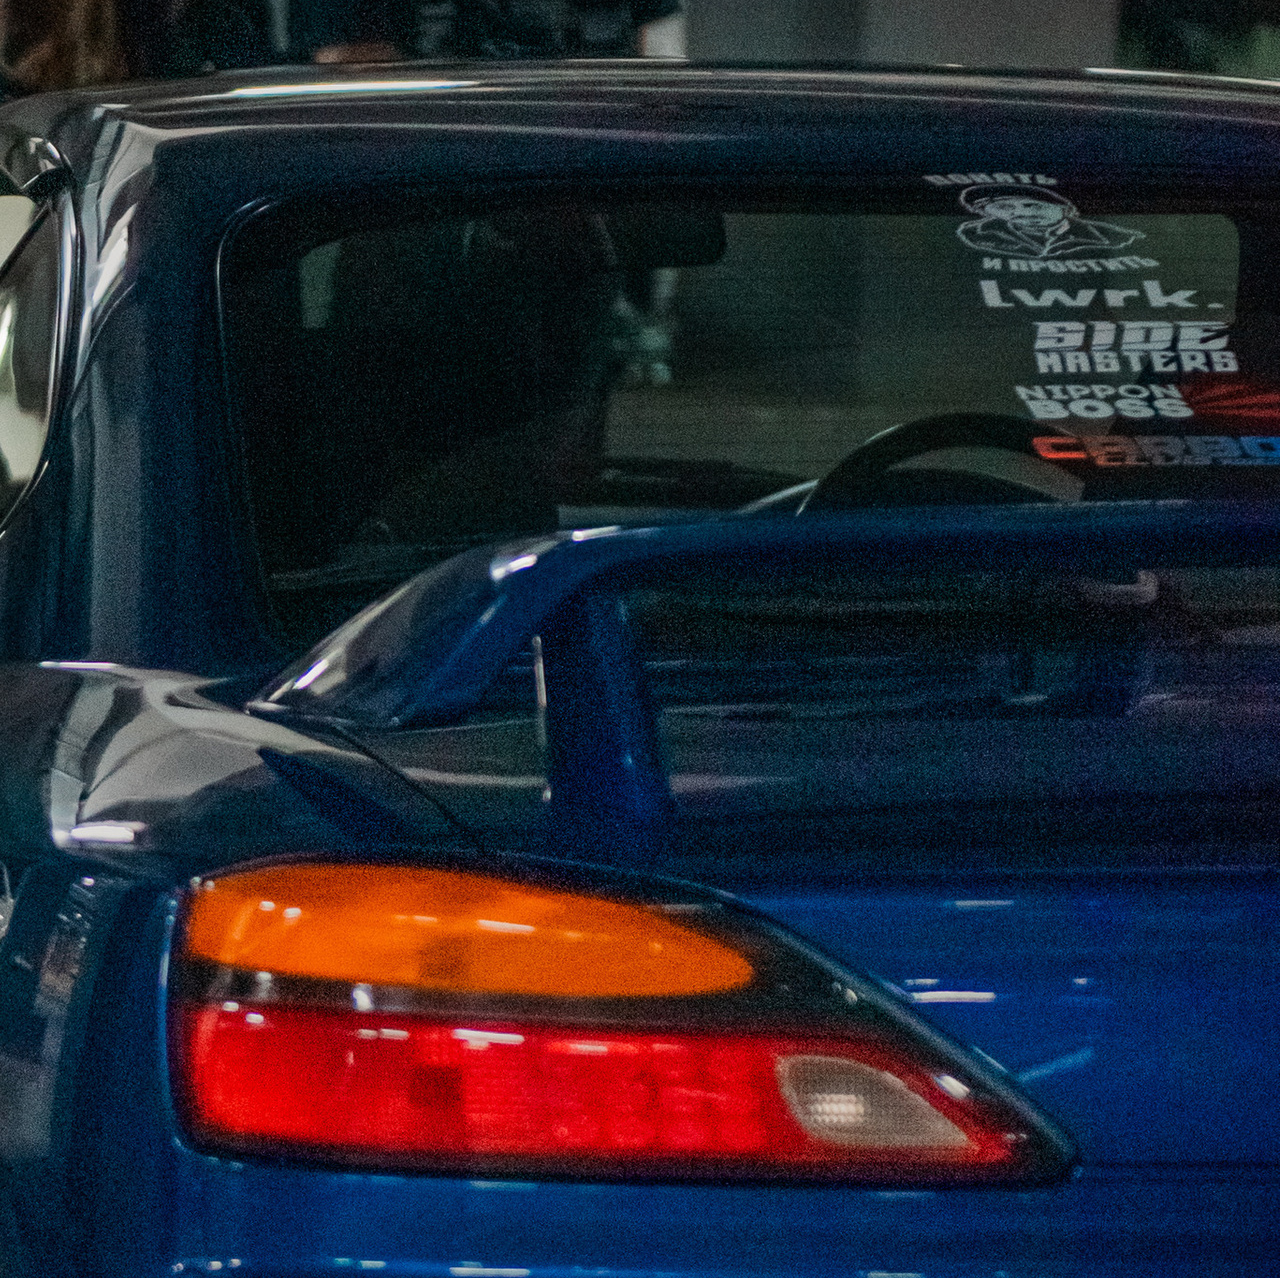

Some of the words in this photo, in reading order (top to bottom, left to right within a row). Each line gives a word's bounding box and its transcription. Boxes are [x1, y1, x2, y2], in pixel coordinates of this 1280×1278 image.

[1034, 322, 1229, 350] SIDE
[1036, 351, 1239, 372] MASTERS
[1016, 385, 1182, 400] NIPPON
[1026, 399, 1194, 419] BOSS
